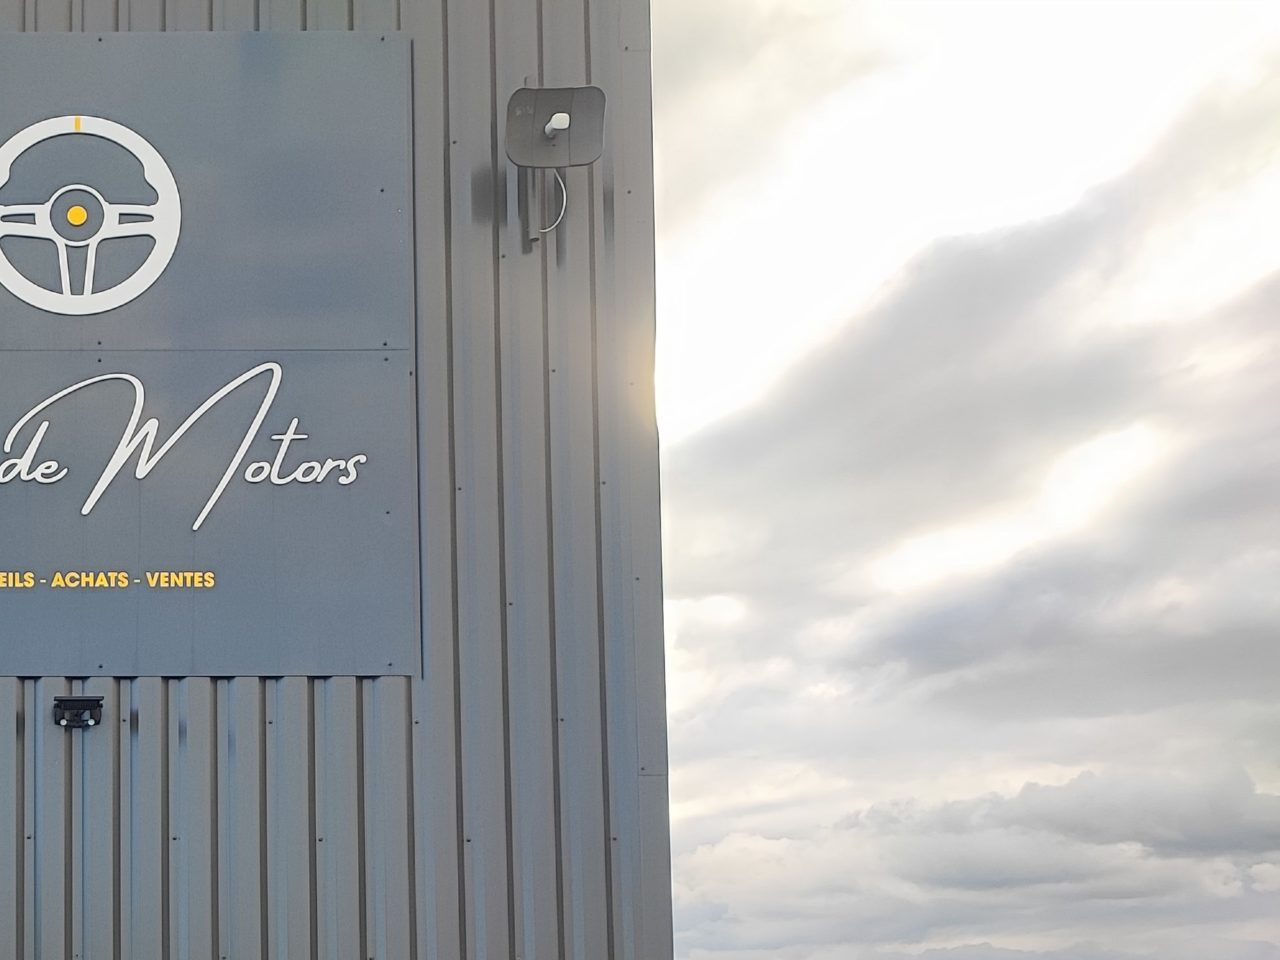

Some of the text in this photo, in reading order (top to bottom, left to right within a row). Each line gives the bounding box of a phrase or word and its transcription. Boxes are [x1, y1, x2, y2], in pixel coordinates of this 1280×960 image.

[3, 361, 368, 532] Motors
[51, 571, 129, 588] ACHATS
[145, 571, 215, 588] VENTES
